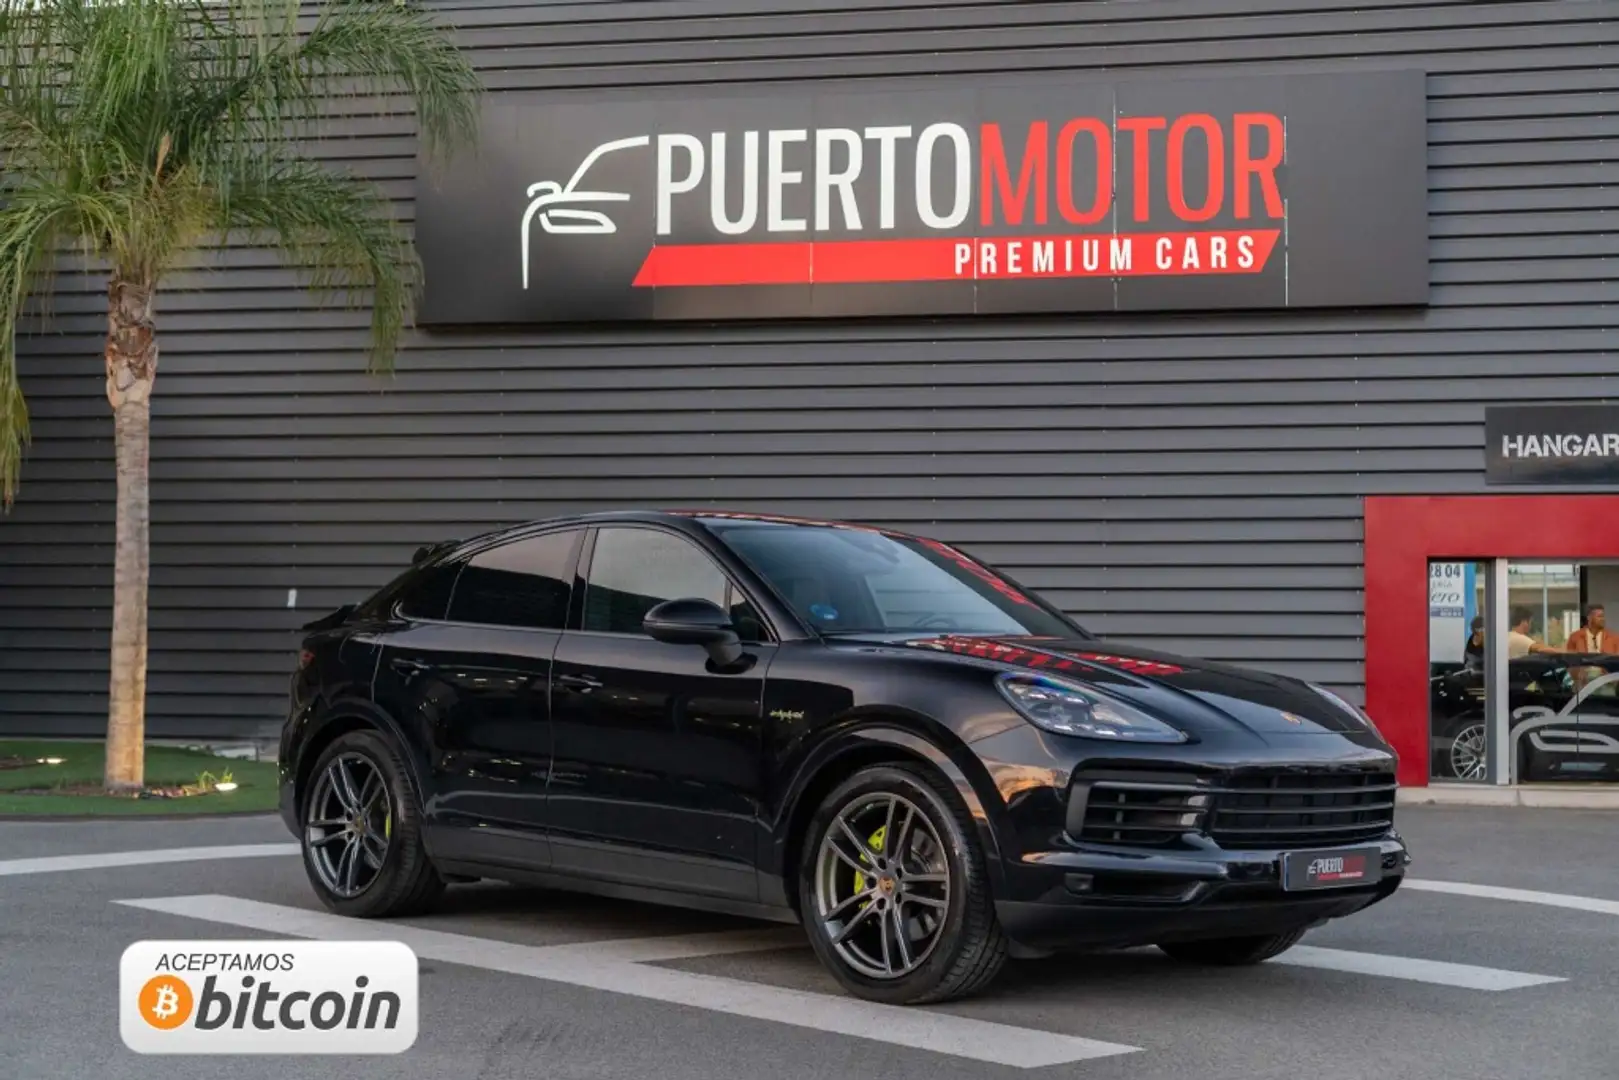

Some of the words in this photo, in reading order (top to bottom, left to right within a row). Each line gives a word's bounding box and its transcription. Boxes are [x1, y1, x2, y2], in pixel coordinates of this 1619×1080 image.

[656, 112, 1285, 235] PUERTOMOTOR
[954, 237, 1132, 275] PREMIUM
[1155, 235, 1255, 270] CARS
[1502, 433, 1619, 458] HANGAR
